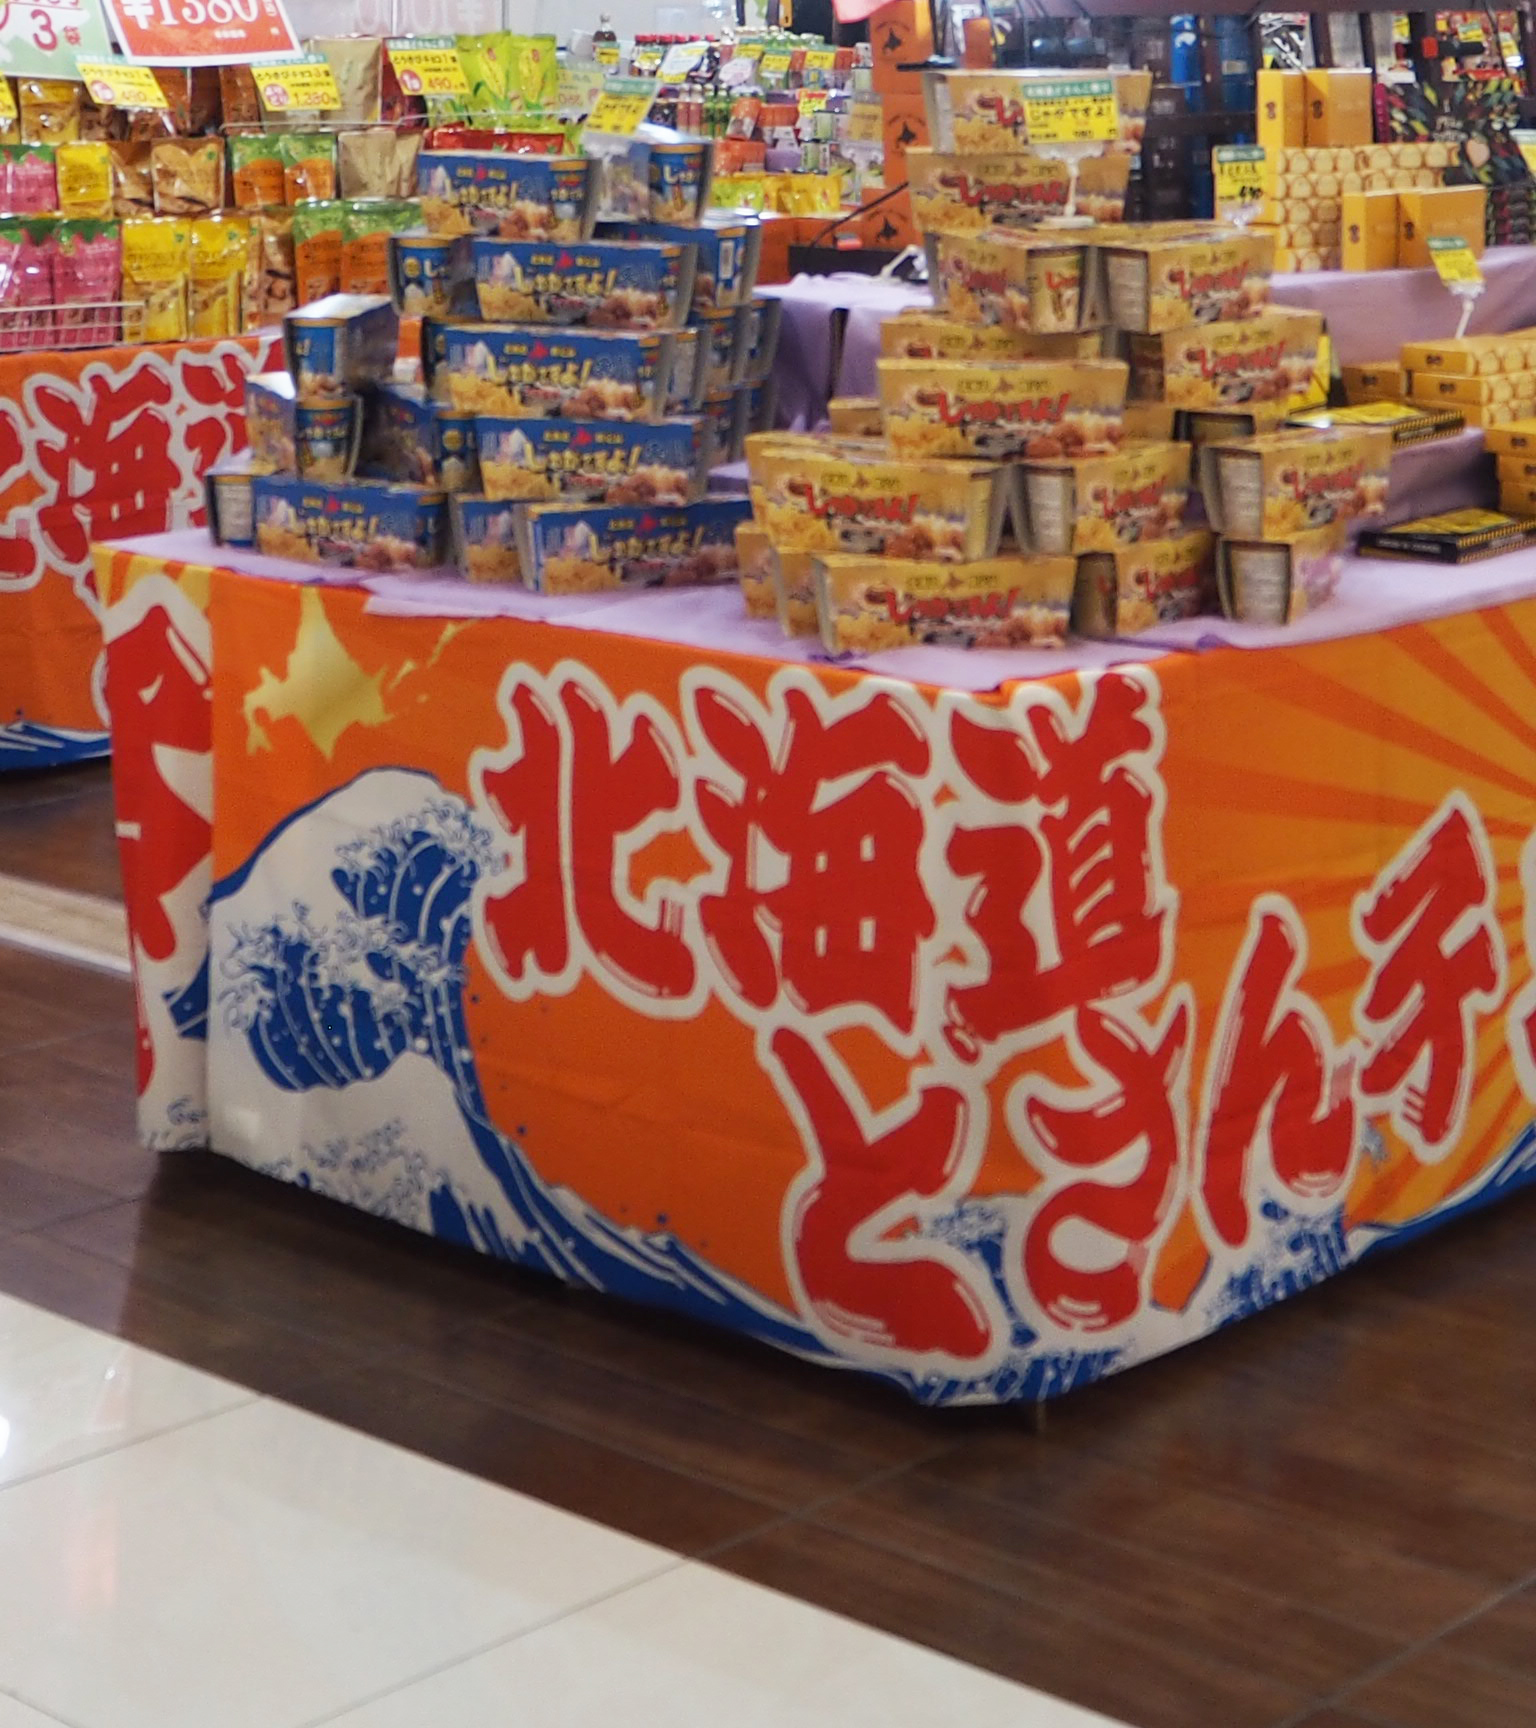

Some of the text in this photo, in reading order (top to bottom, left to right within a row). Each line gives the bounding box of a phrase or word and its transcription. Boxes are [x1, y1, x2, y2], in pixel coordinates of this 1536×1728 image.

[30, 8, 58, 51] 3
[467, 664, 1179, 1052] 北海道
[757, 788, 1513, 1377] どさん子
